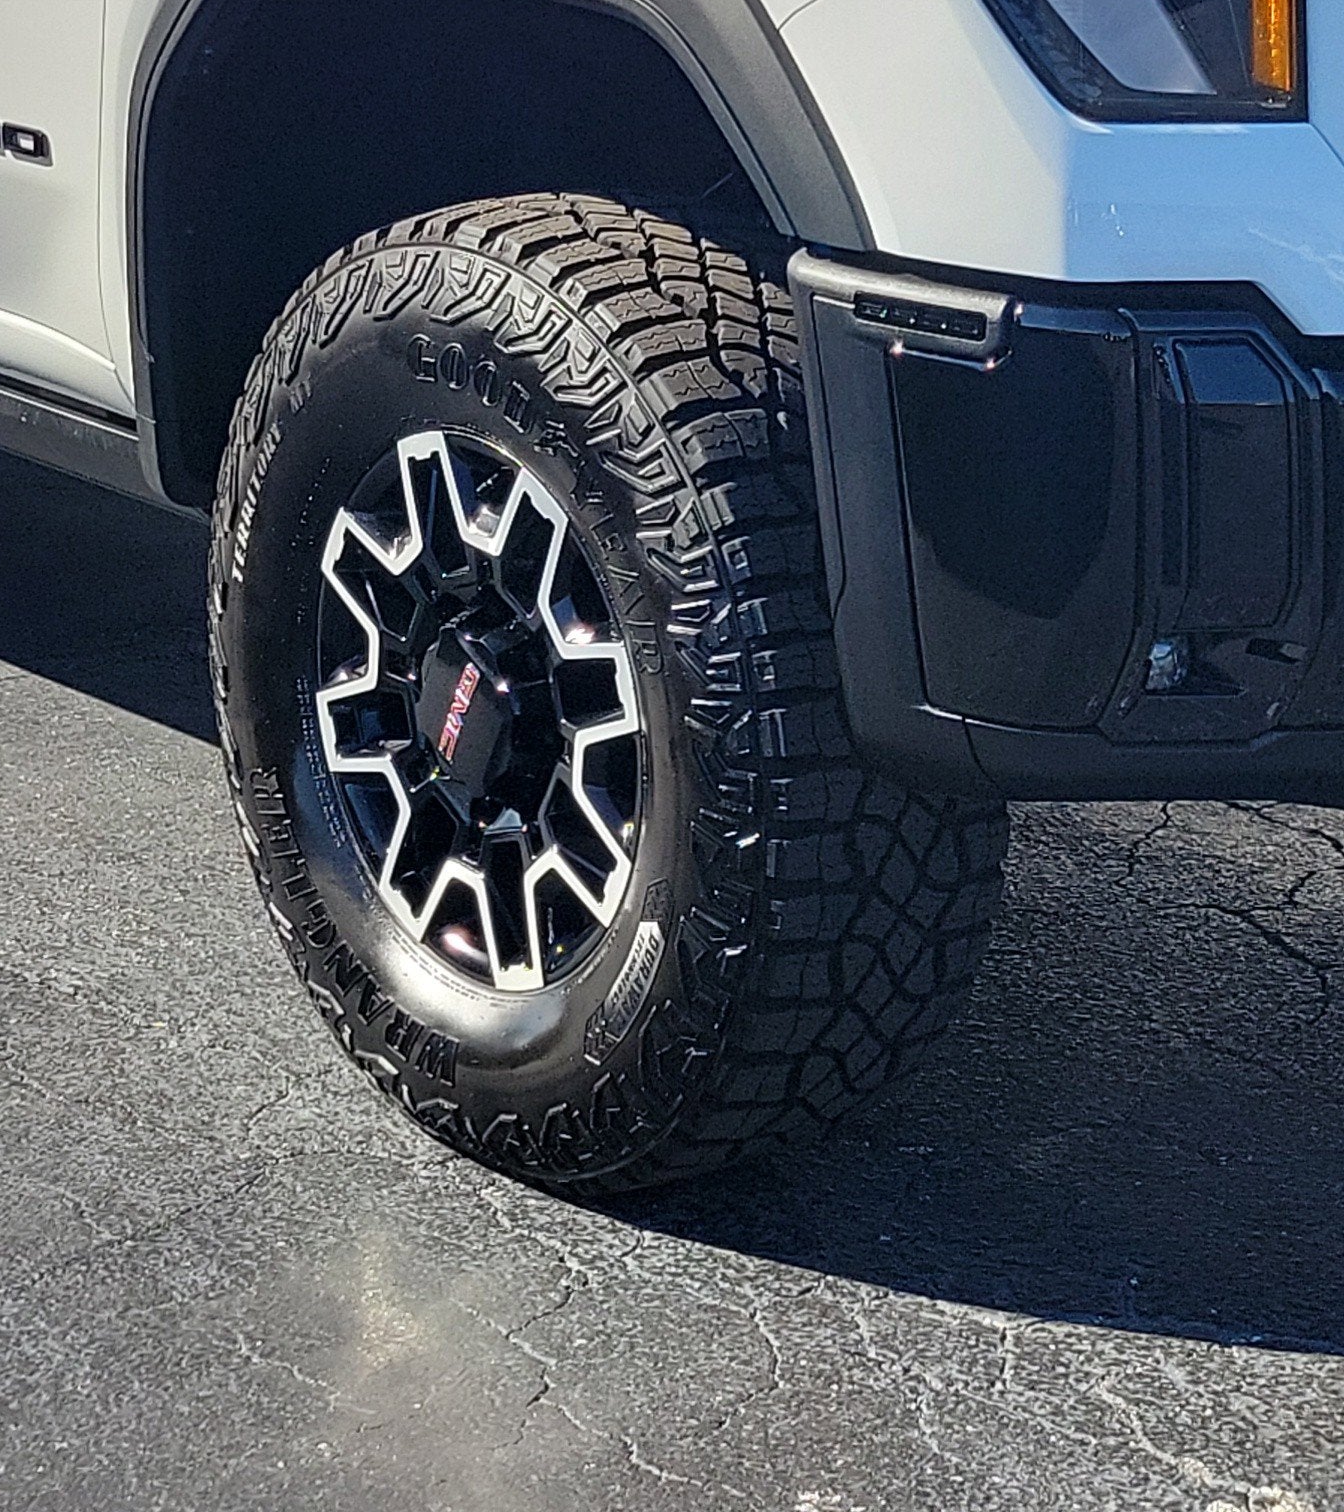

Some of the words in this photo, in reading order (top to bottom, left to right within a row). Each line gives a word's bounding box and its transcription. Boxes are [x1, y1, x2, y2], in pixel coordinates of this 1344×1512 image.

[231, 421, 283, 584] TERRITORY
[406, 333, 664, 675] GOODYEAR
[438, 661, 481, 762] GMC
[252, 766, 460, 1087] WRANGLER
